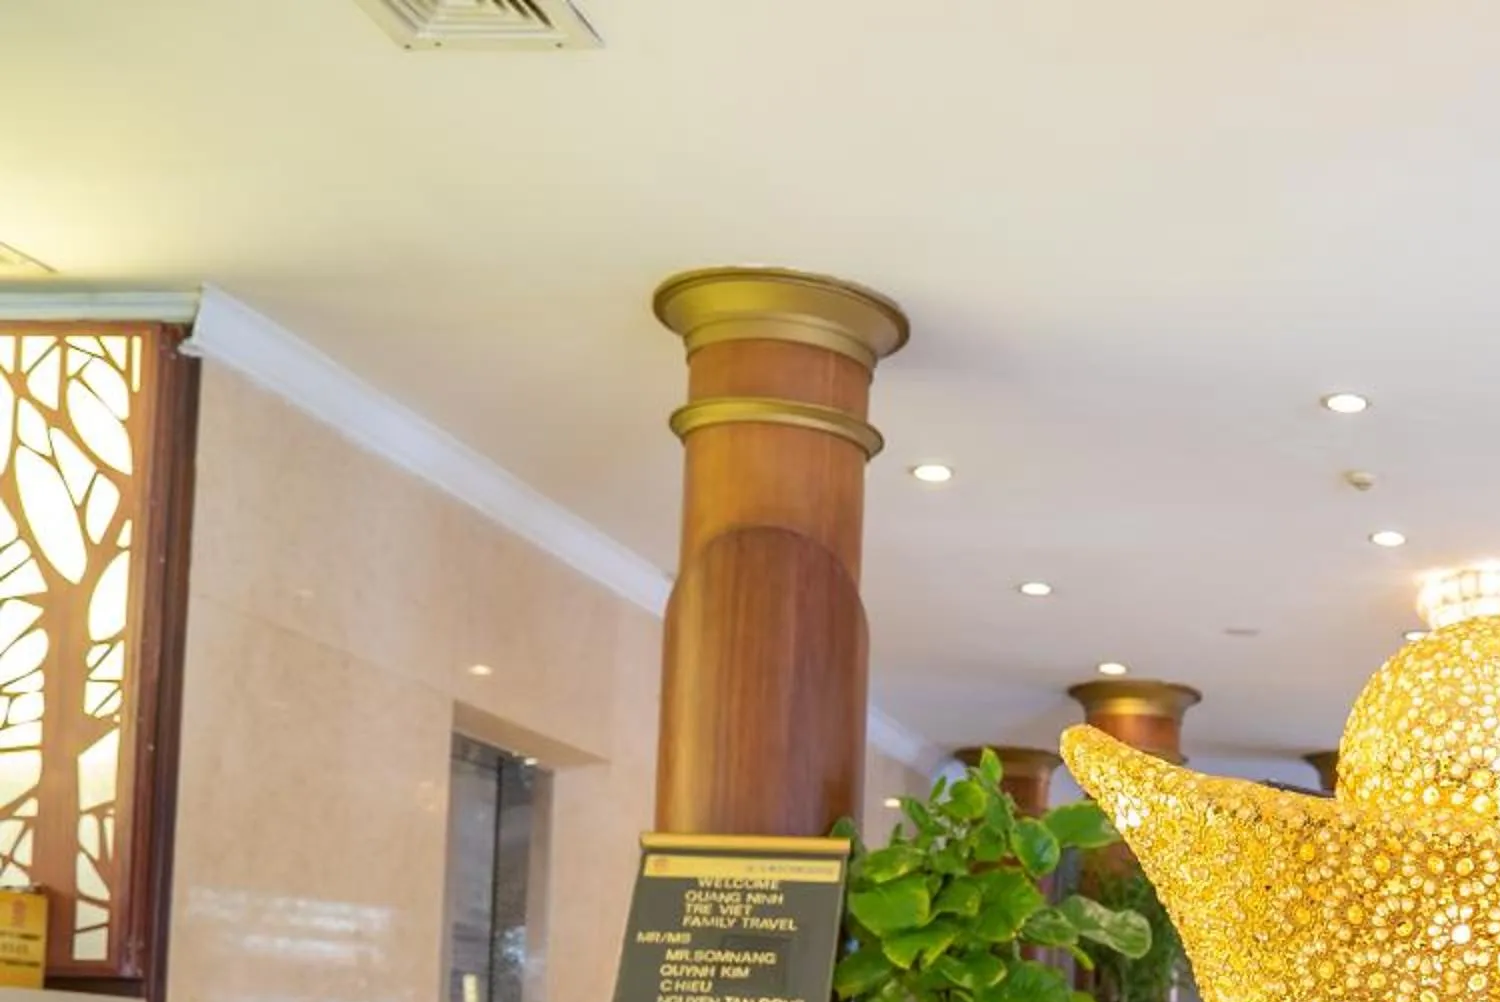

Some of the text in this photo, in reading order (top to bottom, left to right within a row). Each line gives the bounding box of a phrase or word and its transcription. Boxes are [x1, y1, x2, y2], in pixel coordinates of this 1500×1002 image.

[720, 904, 753, 917] VIET
[682, 915, 799, 931] FAMILY TRAVEL
